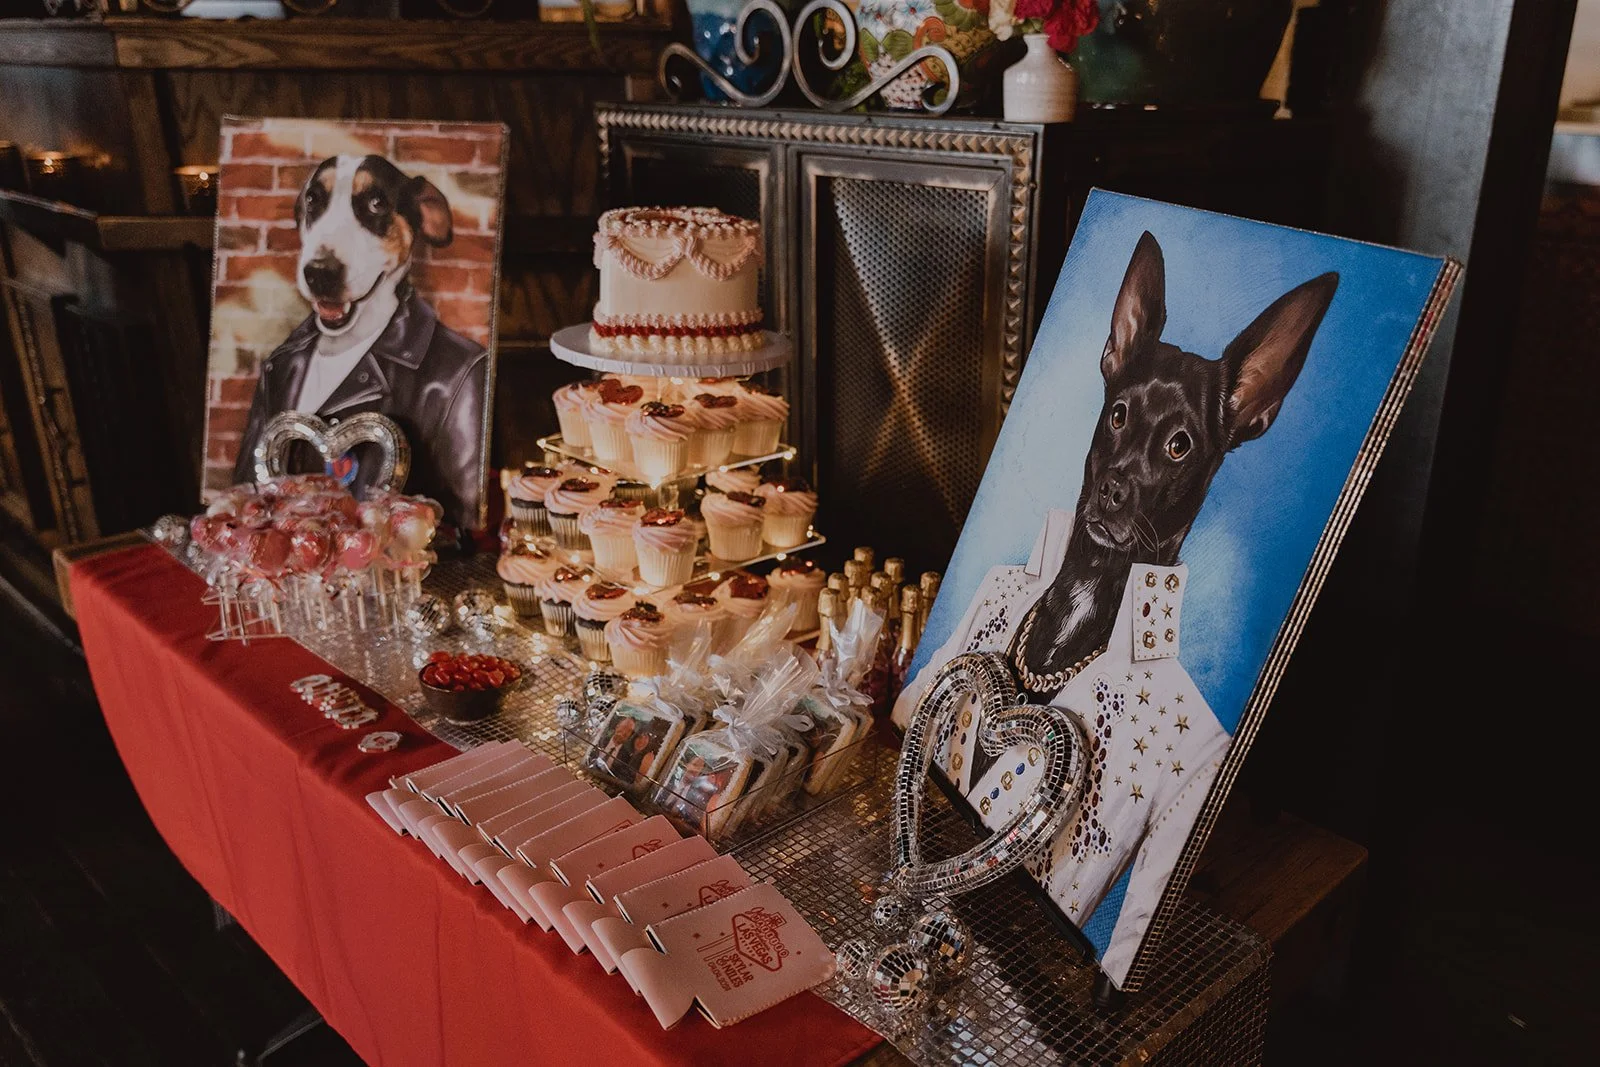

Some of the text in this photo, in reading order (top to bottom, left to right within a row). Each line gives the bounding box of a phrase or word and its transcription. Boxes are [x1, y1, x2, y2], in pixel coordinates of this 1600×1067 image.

[737, 923, 754, 939] LAS
[749, 937, 773, 964] VEGAS
[721, 963, 744, 988] NILES
[729, 953, 754, 983] SKYLAR
